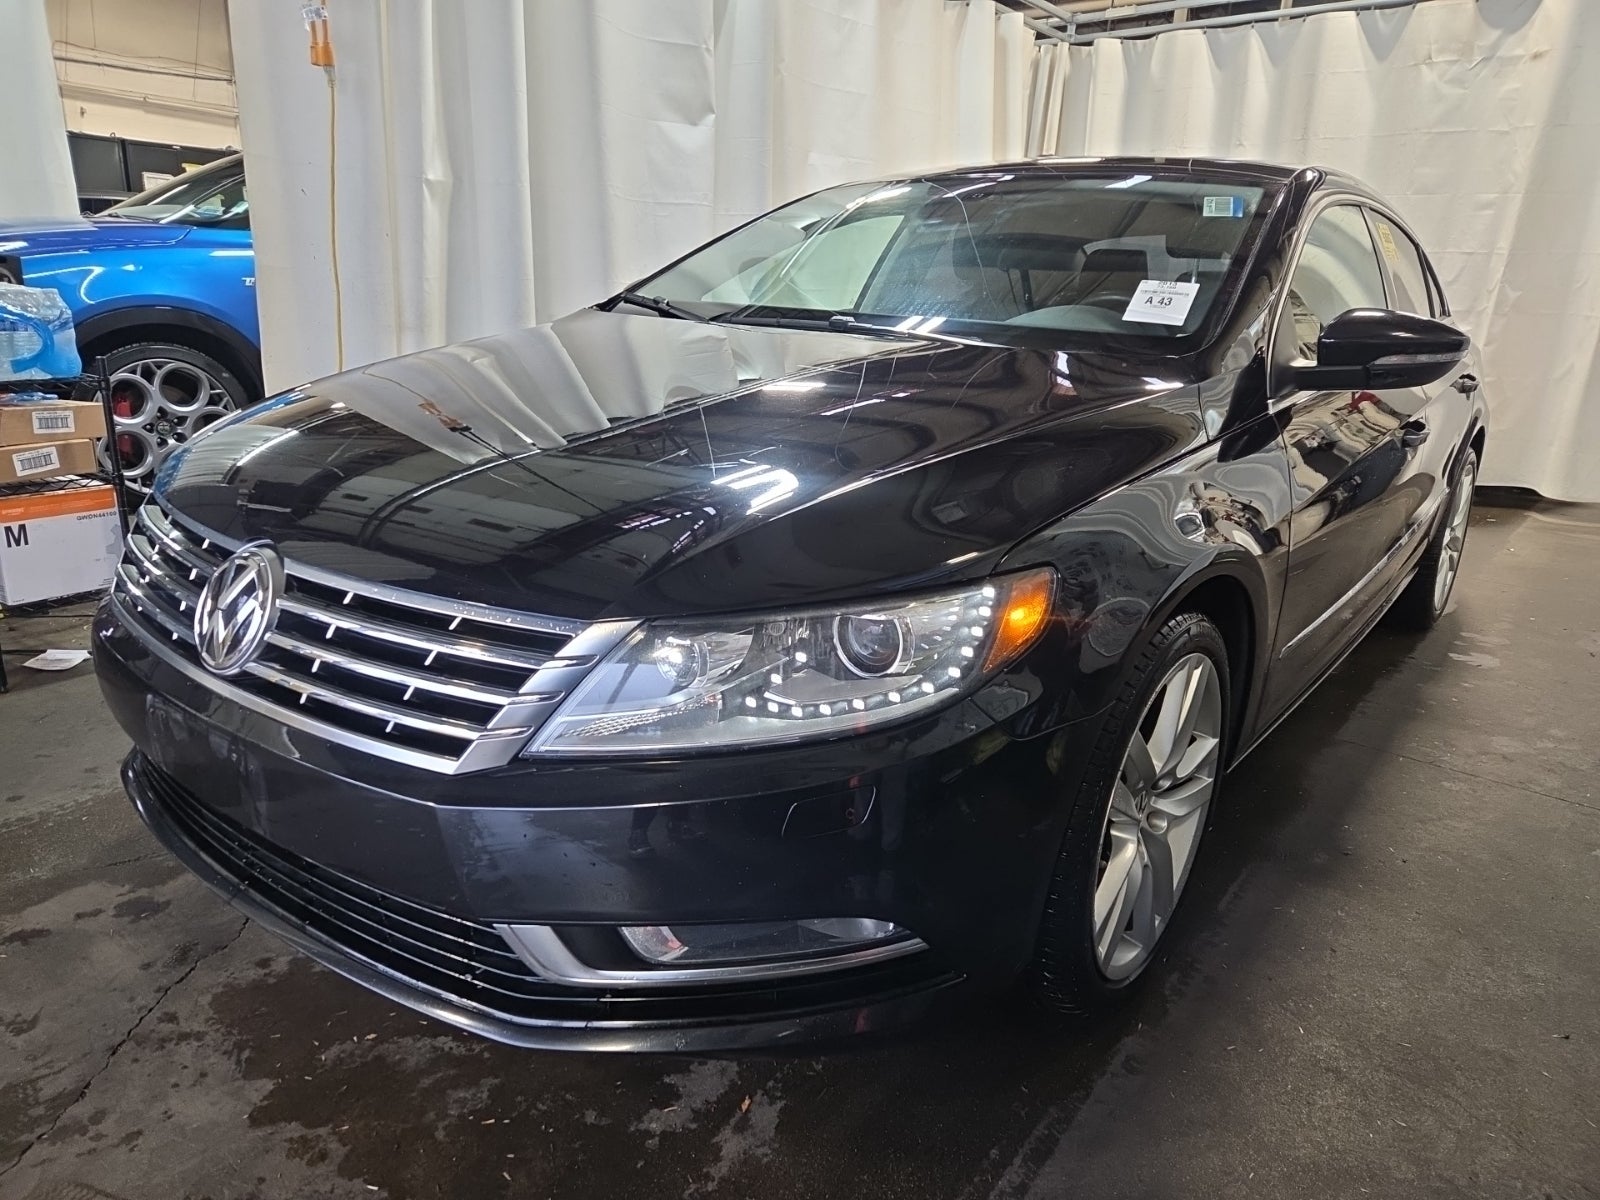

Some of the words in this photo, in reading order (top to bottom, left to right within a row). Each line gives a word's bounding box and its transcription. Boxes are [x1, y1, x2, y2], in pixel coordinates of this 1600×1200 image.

[1144, 296, 1153, 305] A
[1157, 296, 1173, 306] 43
[3, 523, 29, 548] M
